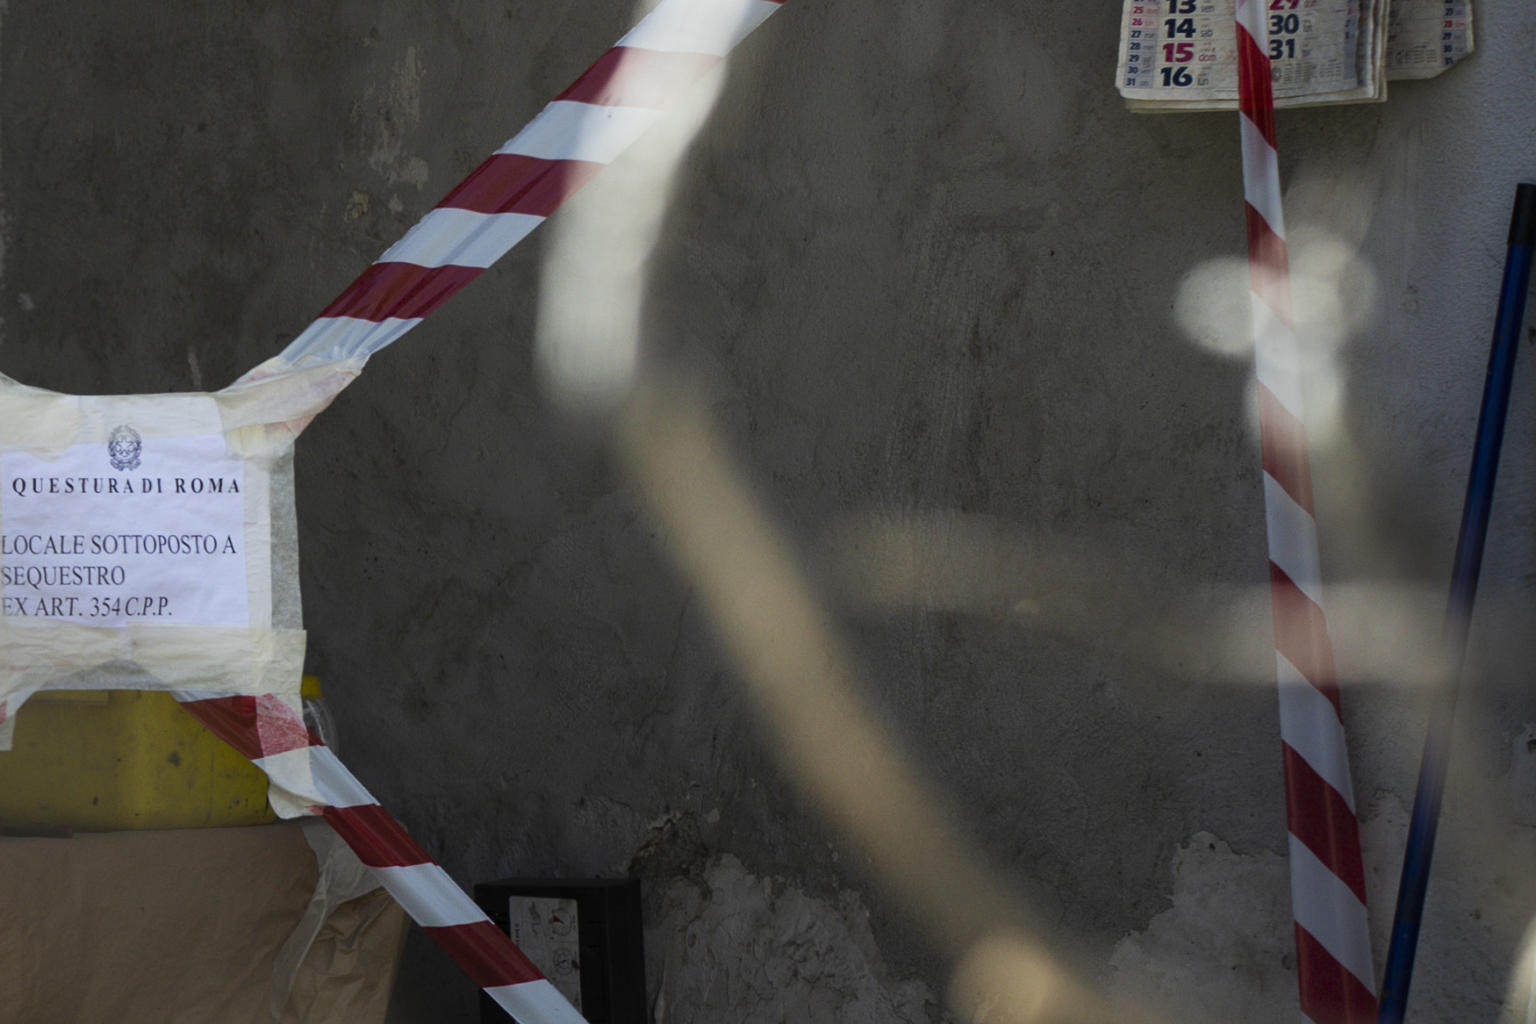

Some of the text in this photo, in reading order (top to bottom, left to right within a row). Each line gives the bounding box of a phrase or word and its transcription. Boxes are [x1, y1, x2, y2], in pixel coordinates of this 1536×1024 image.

[1133, 6, 1144, 15] 25
[1131, 18, 1143, 27] 26
[1164, 17, 1197, 38] 14
[1268, 13, 1300, 36] 30
[1130, 30, 1142, 39] 27
[1129, 42, 1141, 51] 28
[1162, 42, 1195, 63] 15
[1268, 38, 1296, 60] 31
[1128, 54, 1140, 63] 29
[1127, 66, 1138, 75] 30
[1160, 65, 1194, 87] 16
[1125, 78, 1136, 87] 31
[12, 477, 240, 497] QUESTURA DI ROMA
[1, 534, 237, 556] LOCALE SOTTOPOSTO A
[1, 565, 125, 590] SEQUESTRO
[2, 597, 29, 617] EX
[34, 597, 83, 617] ART.
